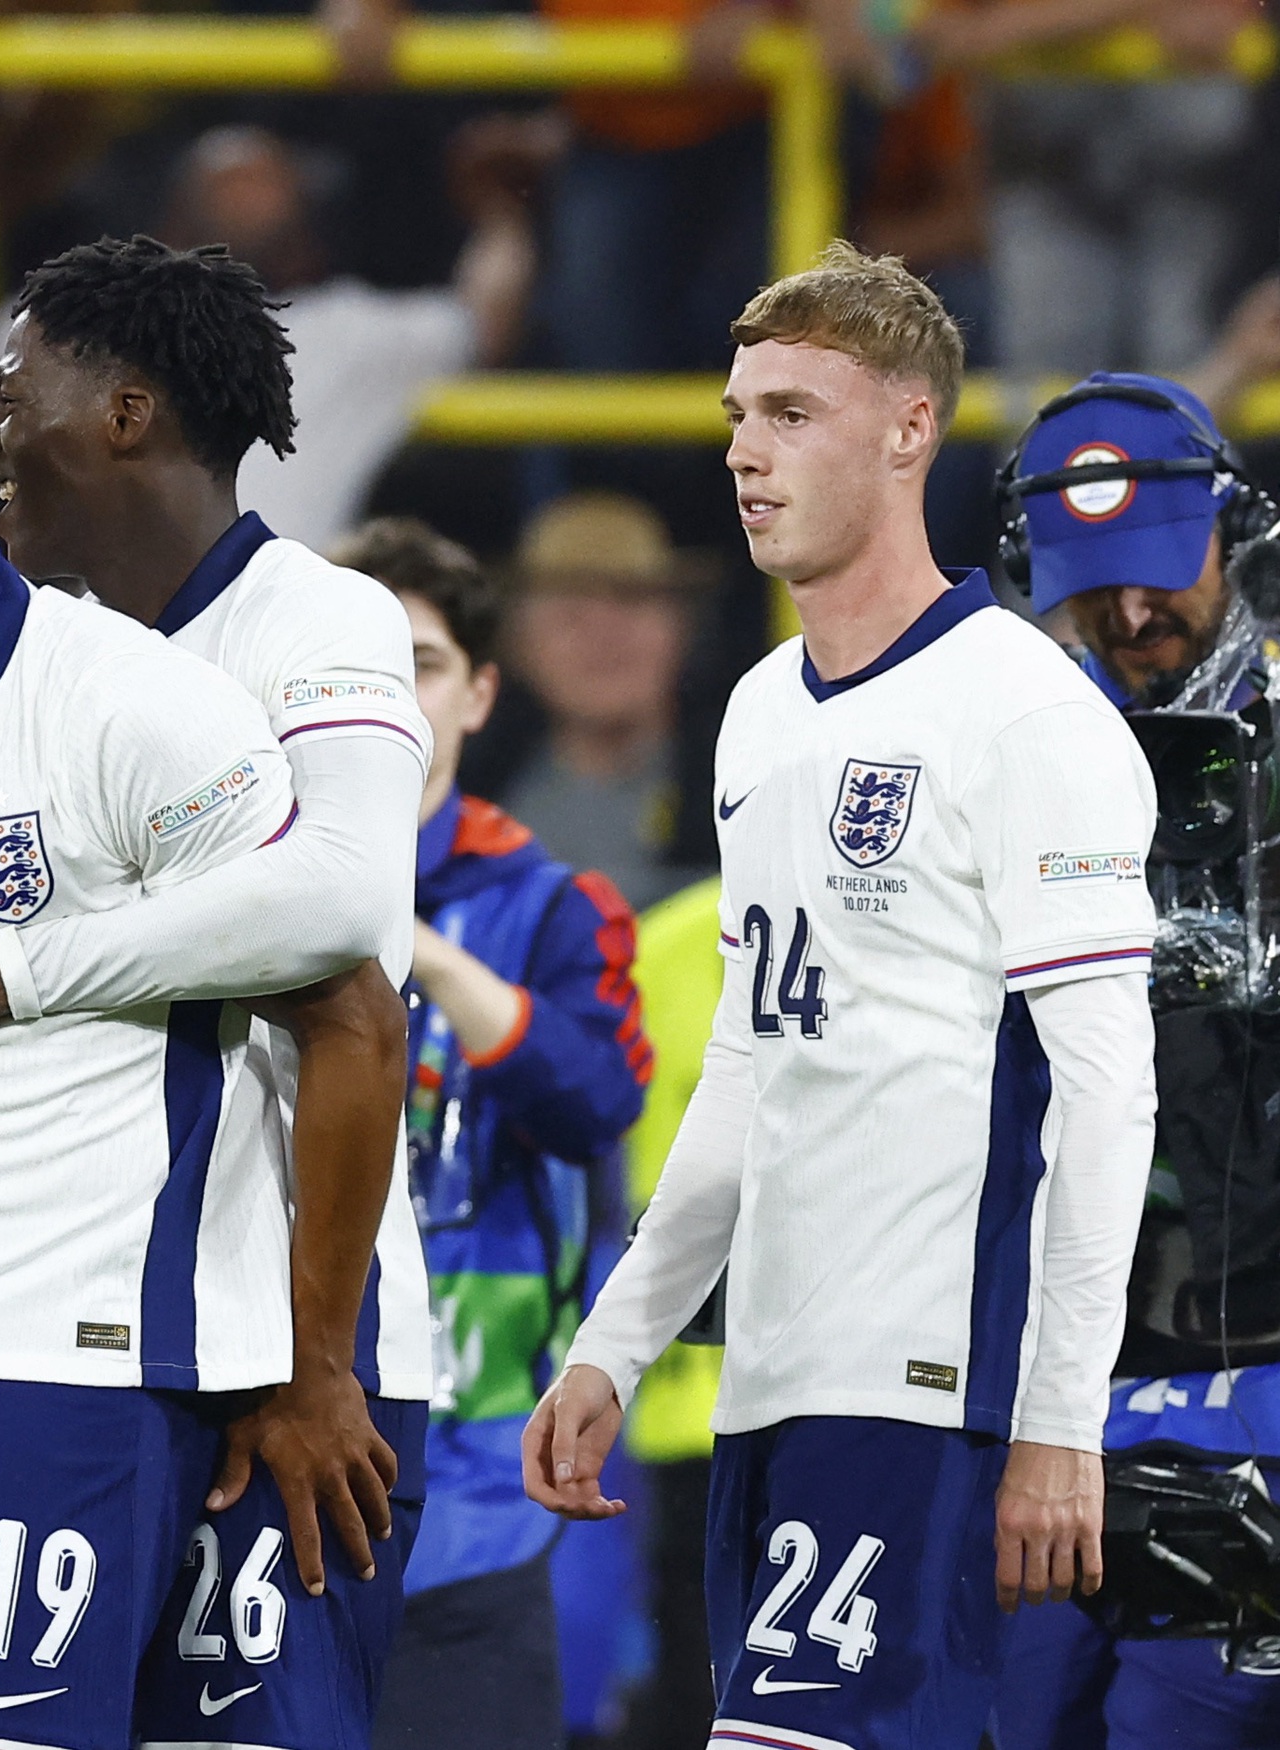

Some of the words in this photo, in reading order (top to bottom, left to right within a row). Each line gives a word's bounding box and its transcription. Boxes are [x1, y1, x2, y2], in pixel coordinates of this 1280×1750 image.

[283, 678, 308, 690] UEFA
[151, 761, 255, 834] FOUNDATION
[147, 804, 173, 824] UEFA
[1038, 851, 1066, 862] UEFA
[1039, 855, 1141, 877] FOUNDATION
[825, 874, 908, 894] NETHERLANDS
[842, 896, 889, 913] 10.07.24
[743, 903, 829, 1040] 24
[177, 1522, 287, 1664] 26
[745, 1519, 886, 1674] 24
